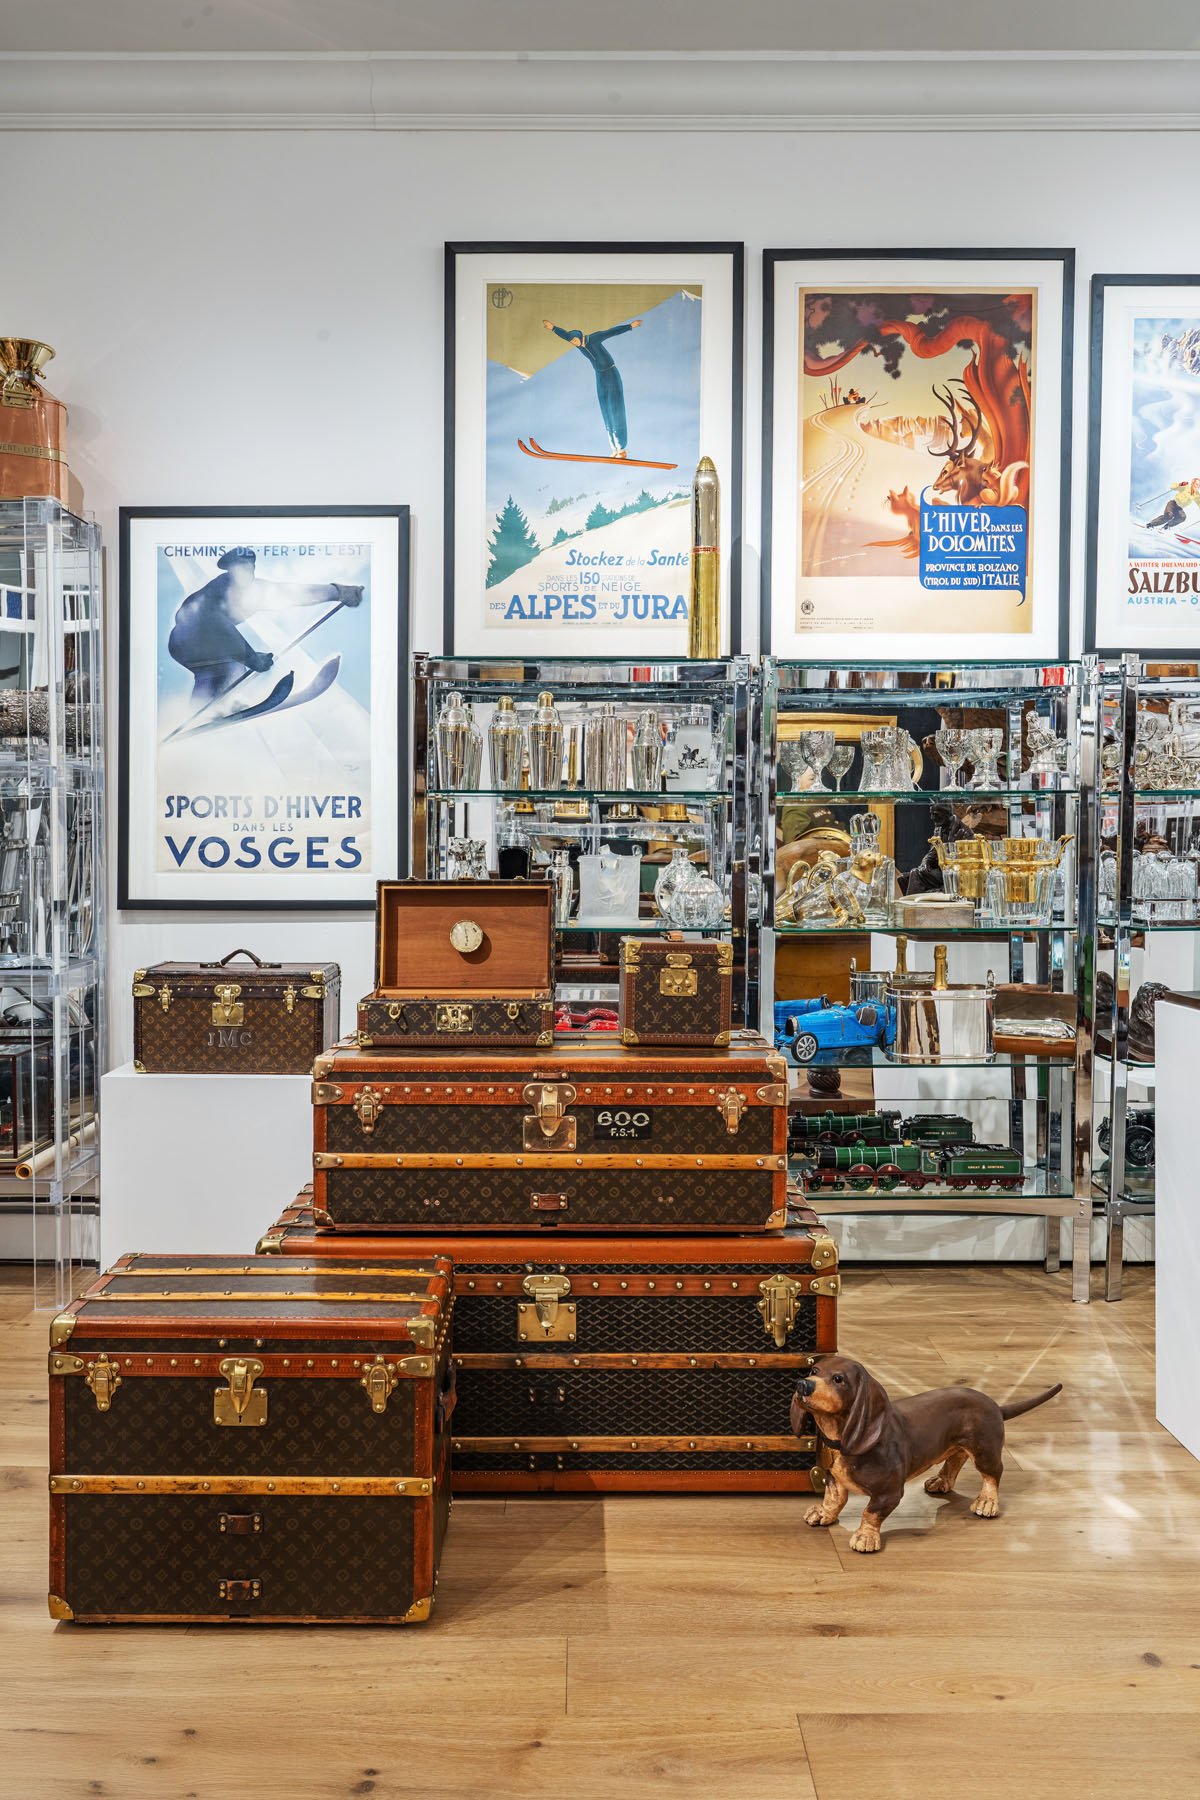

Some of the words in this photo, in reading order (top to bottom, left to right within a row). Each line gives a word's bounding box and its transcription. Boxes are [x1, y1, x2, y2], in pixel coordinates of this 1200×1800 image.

[923, 511, 991, 533] L'HIVER
[991, 524, 1011, 532] DANS
[1012, 524, 1023, 532] LES
[164, 545, 226, 557] CHEMINS
[237, 545, 255, 557] DE
[264, 545, 289, 557] FER
[300, 545, 315, 556] DE
[325, 544, 363, 556] L'EST
[928, 535, 1016, 552] DOLOMITES
[565, 549, 624, 566] Stockez
[625, 556, 637, 566] de
[637, 556, 646, 566] la
[646, 549, 689, 566] Santé
[925, 563, 965, 573] PROVINCE
[966, 563, 976, 572] DE
[978, 563, 1019, 572] BOLZANO
[579, 572, 599, 584] 150
[923, 576, 949, 588] (TIROL
[951, 577, 961, 586] DU
[963, 576, 981, 587] SUD)
[982, 574, 1020, 586] ITALIE
[538, 582, 579, 592] SPORTS
[602, 582, 642, 592] NEIGE
[489, 602, 506, 610] DES
[504, 595, 597, 620] ALPES
[609, 602, 620, 610] DU
[613, 595, 689, 620] JURA
[1128, 597, 1177, 605] AUSTRIA
[164, 795, 253, 819] SPORTS
[264, 795, 362, 819] D'HIVER
[233, 823, 265, 832] DANS
[273, 823, 294, 832] LES
[164, 836, 362, 869] VOSGES
[597, 1111, 650, 1127] 600
